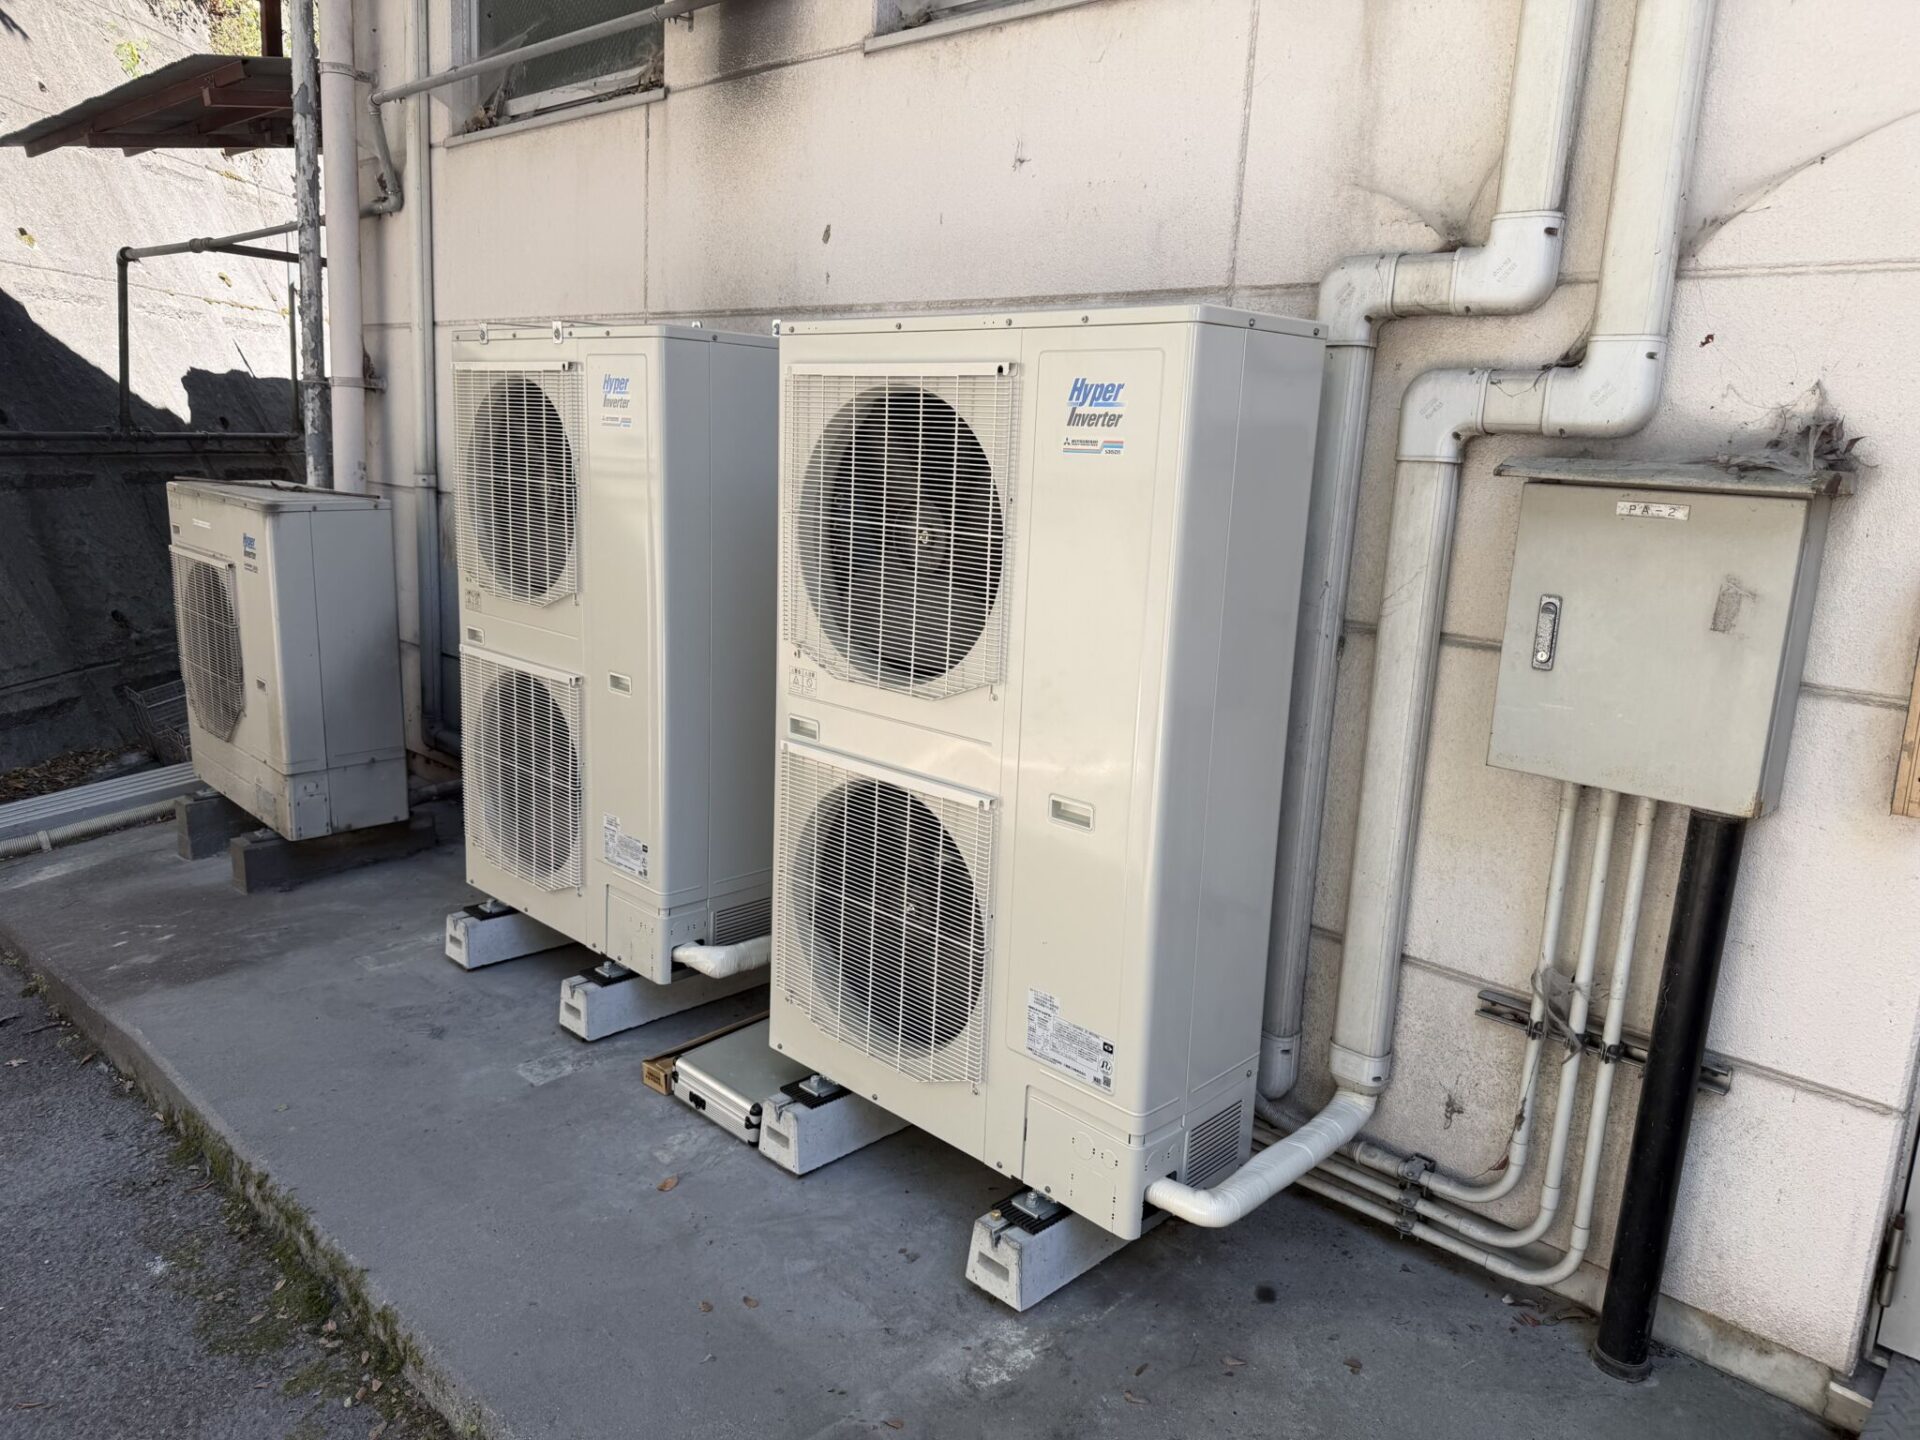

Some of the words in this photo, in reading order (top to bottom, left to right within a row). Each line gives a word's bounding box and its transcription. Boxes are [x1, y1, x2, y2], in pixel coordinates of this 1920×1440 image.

[603, 373, 629, 394] Hyper
[1068, 378, 1125, 407] Hyper
[603, 394, 630, 409] Inverter
[1066, 407, 1123, 428] Inverter
